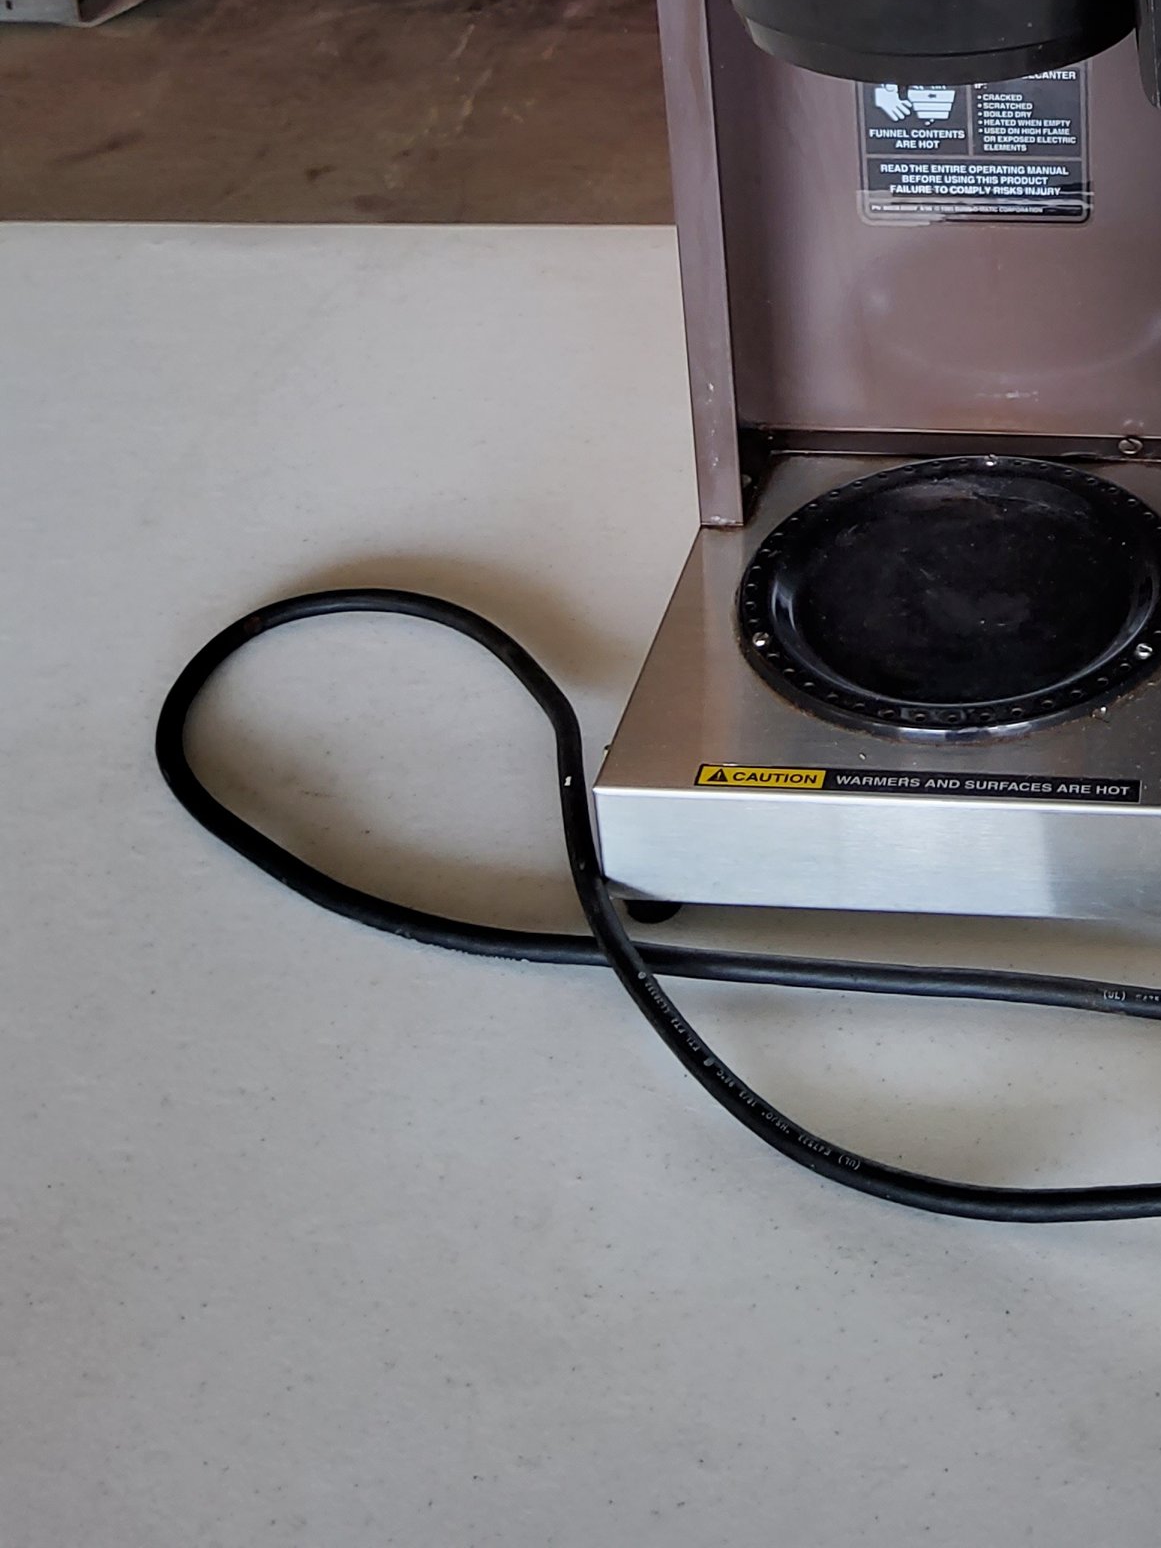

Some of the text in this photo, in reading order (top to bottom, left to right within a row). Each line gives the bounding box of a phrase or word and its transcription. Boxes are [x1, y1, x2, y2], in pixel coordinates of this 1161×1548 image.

[983, 102, 1033, 110] SCRATCHED
[1018, 119, 1042, 127] WHEN
[869, 129, 965, 139] FUNNEL CONTENTS
[984, 127, 1006, 135] USED
[895, 139, 940, 149] ARE HOT
[1037, 136, 1076, 144] ELECTRIC
[983, 144, 1027, 152] ELEMENTS
[880, 164, 1069, 175] READ THE ENTIRE OPERATING MANUAL
[902, 175, 1049, 185] BEFORE USING THIS PRODUCT
[890, 185, 1061, 196] FAILURE TO COMPLY RISKS INJURY
[731, 771, 1130, 795] CAUTION WARMERS AND SURFACES ARE HOT
[839, 1154, 861, 1170] (UL)
